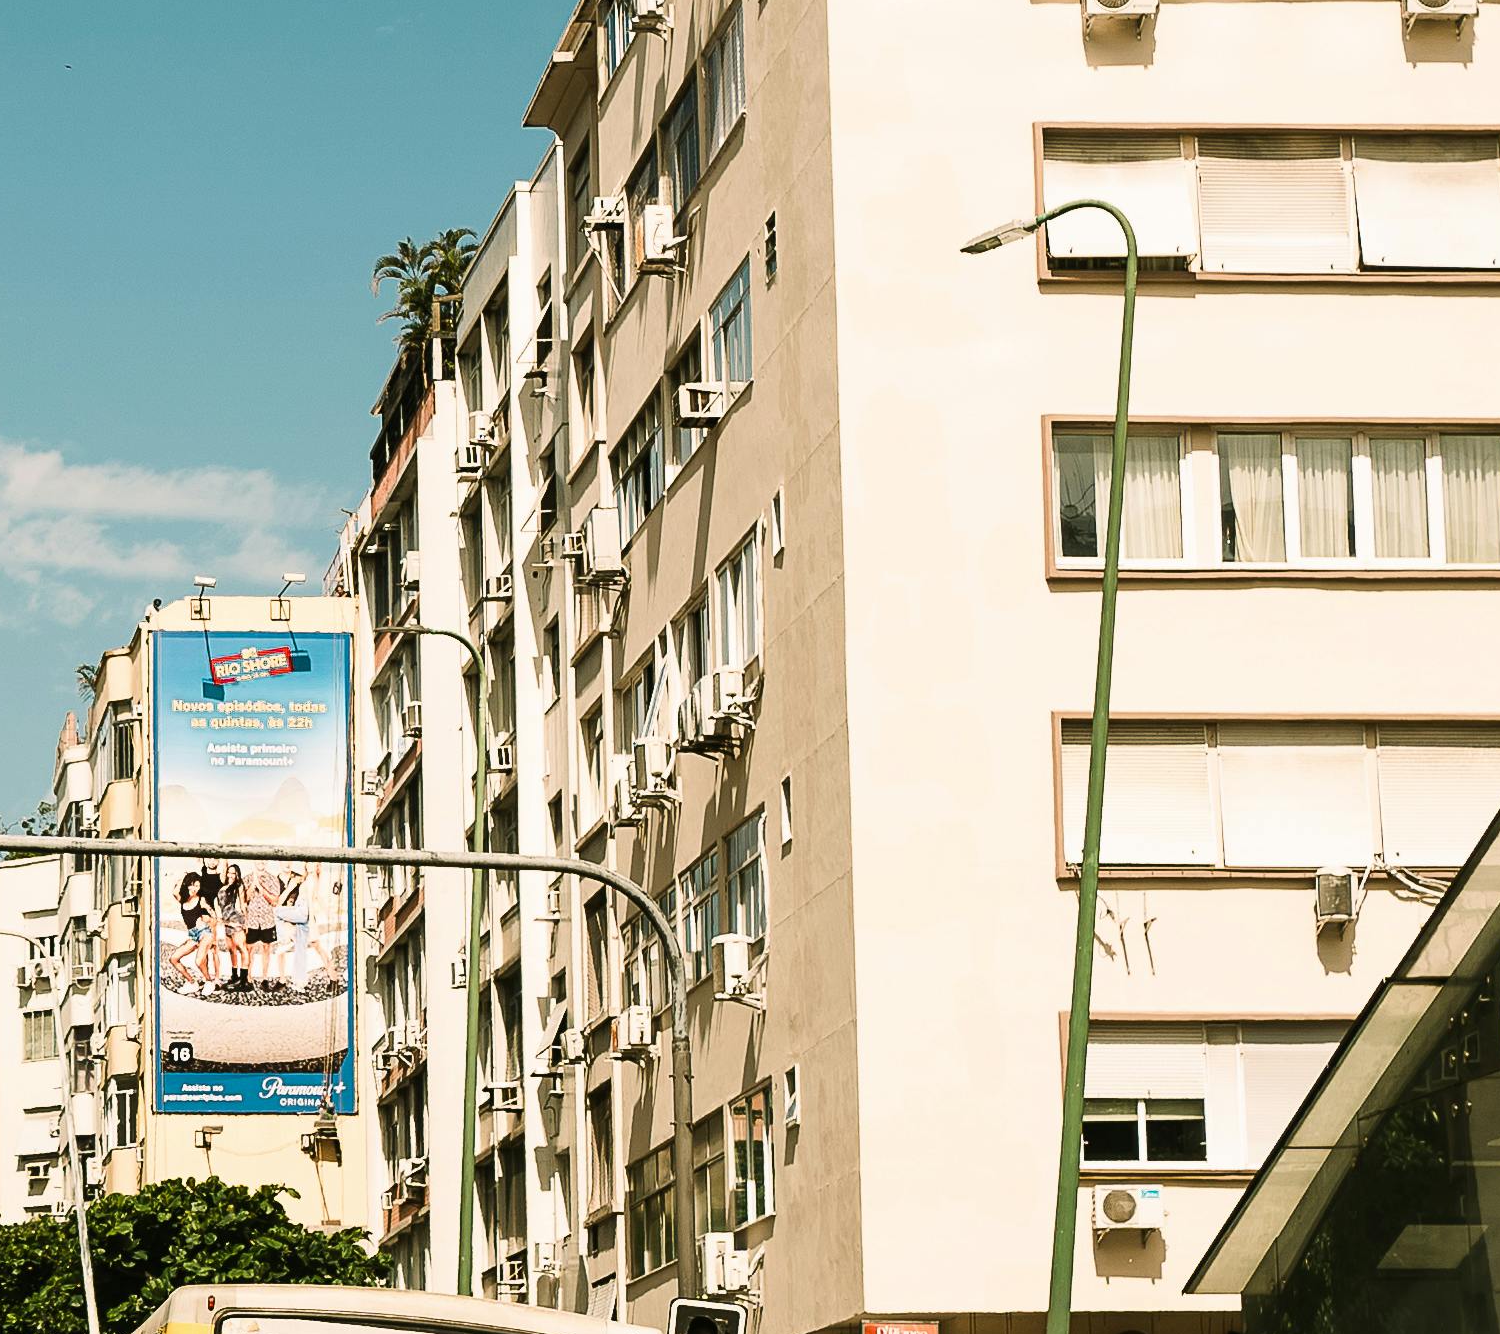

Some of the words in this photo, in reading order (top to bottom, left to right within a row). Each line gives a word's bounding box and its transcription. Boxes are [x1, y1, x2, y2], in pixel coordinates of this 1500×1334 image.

[214, 662, 240, 678] RIO
[242, 653, 288, 672] SHORE
[171, 700, 214, 712] Novos
[289, 701, 327, 712] todas
[207, 743, 248, 754] Assista
[250, 743, 297, 756] primeiro
[171, 1047, 191, 1062] 16
